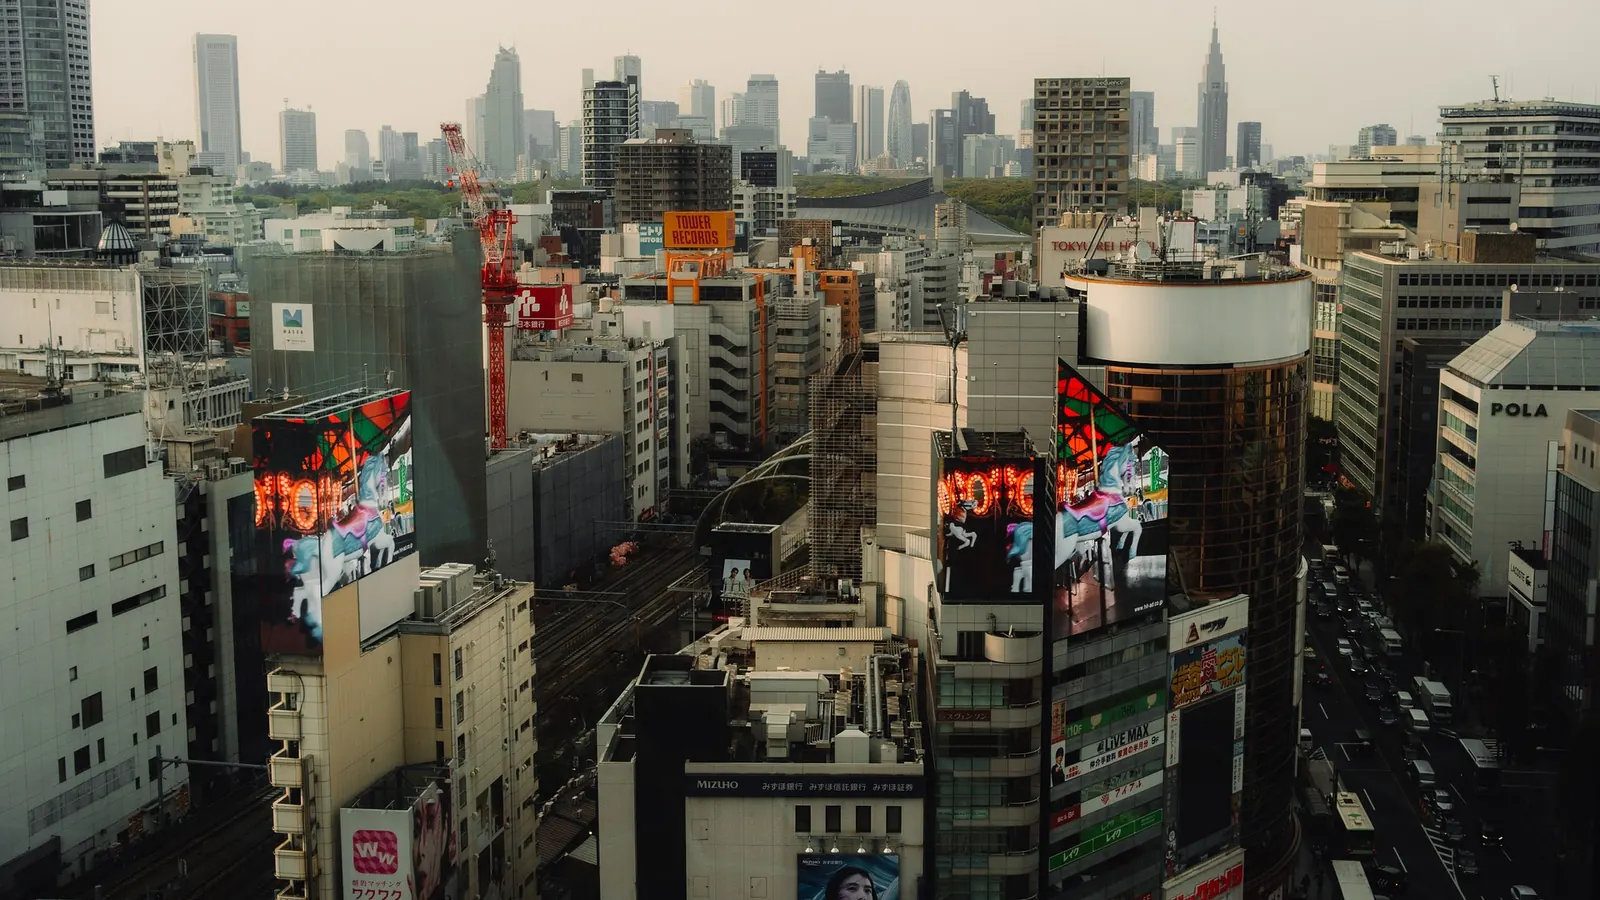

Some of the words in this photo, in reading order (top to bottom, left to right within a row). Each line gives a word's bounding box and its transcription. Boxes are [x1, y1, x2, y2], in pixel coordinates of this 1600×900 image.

[676, 215, 711, 229] TOWER
[640, 226, 663, 236] ニトリ
[672, 230, 719, 244] RECORDS
[1491, 403, 1548, 417] POLA
[1127, 723, 1150, 744] MAX
[696, 780, 739, 789] MIZUHO
[762, 782, 803, 791] みずほ銀行
[809, 782, 867, 792] みずほ信託銀行
[873, 782, 914, 792] みずほ証券
[1106, 828, 1122, 842] レイク
[1063, 847, 1079, 862] レイク
